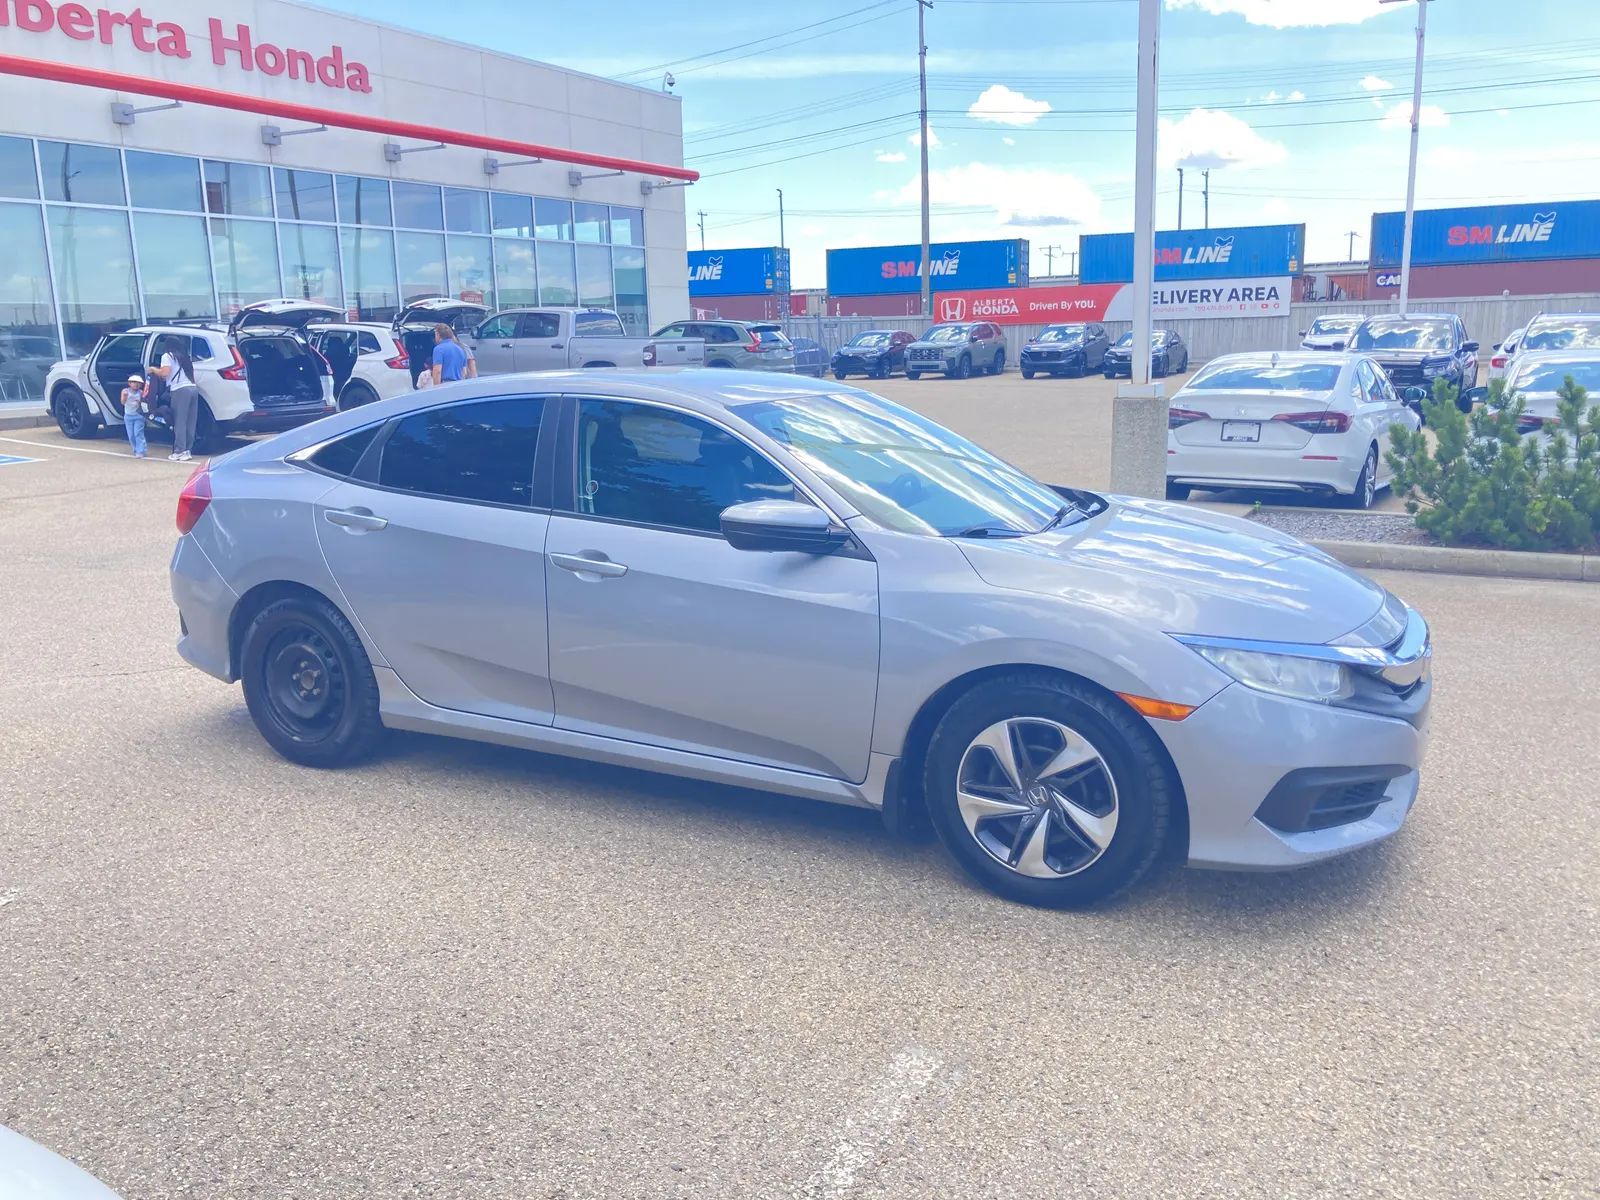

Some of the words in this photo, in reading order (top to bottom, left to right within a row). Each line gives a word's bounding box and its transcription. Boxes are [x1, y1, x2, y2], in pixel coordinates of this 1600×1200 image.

[208, 17, 373, 94] Honda
[1447, 225, 1493, 246] SM
[1495, 223, 1554, 243] LINE
[1183, 246, 1233, 264] LINE
[688, 265, 722, 281] LINE
[881, 261, 915, 279] SM
[973, 298, 1015, 306] ALBERTA
[1227, 286, 1280, 302] AREA
[973, 305, 1019, 315] HONDA
[1029, 303, 1058, 311] Driven
[1061, 301, 1073, 311] By
[1074, 300, 1097, 309] YOU.
